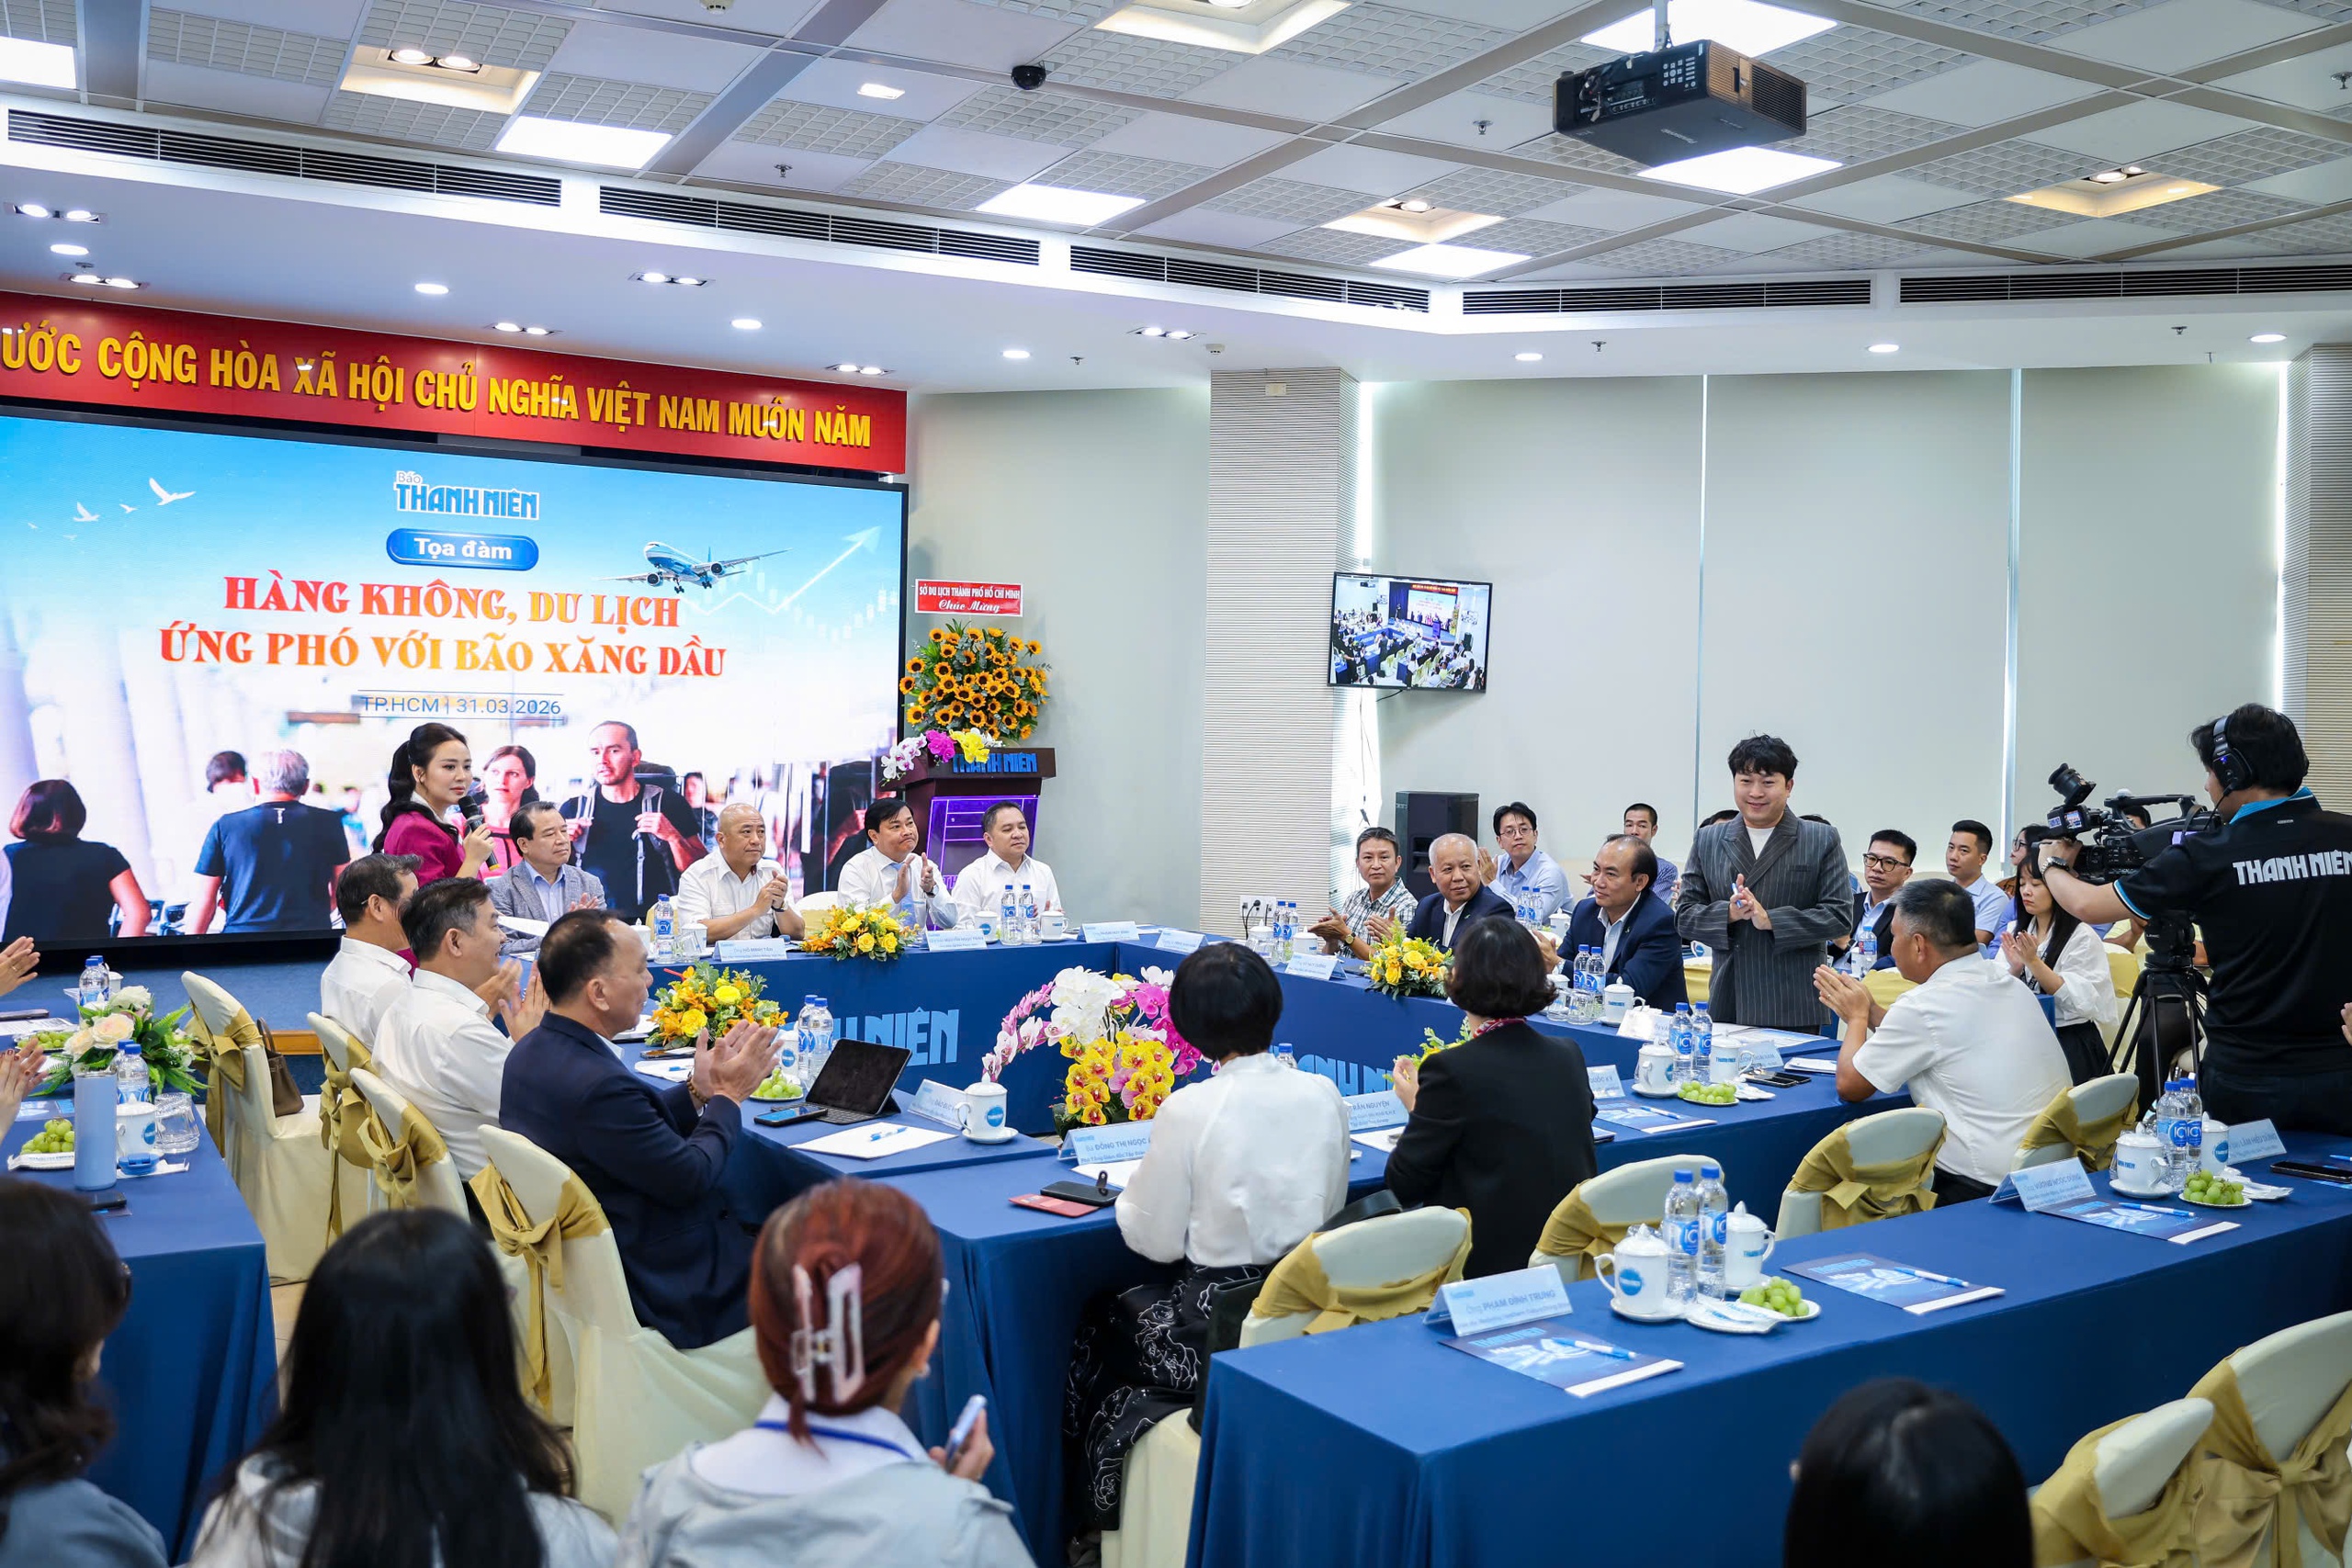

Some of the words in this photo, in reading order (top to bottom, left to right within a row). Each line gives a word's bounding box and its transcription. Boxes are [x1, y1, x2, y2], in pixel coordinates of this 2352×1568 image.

[97, 332, 196, 390] CỘNG
[210, 340, 280, 391] HÒA
[293, 351, 337, 397] XÃ
[349, 355, 404, 411] HỘI
[415, 362, 478, 410] CHỦ
[489, 375, 579, 420] NGHĨA
[587, 380, 650, 433] VIỆT
[659, 395, 719, 434] NAM
[729, 396, 805, 441] MUÔN
[814, 405, 871, 448] NĂM
[395, 483, 480, 514] THANH
[482, 488, 538, 520] NIÊN
[413, 537, 456, 559] Tọa
[461, 539, 513, 559] đàm
[224, 570, 351, 614] HÀNG
[359, 579, 517, 626] KHÔNG,
[528, 591, 583, 624] DU
[592, 593, 681, 634] LỊCH
[939, 599, 966, 610] Chúc
[160, 622, 254, 665] ỨNG
[266, 626, 359, 667] PHÓ
[370, 630, 444, 671] VỚI
[455, 633, 534, 672] BÃO
[544, 637, 648, 676] XĂNG
[659, 634, 727, 677] DẦU
[360, 696, 439, 712] TP.HCM
[457, 698, 561, 715] 31.03.2026
[1003, 752, 1038, 773] NIÊN
[2233, 854, 2309, 886] THANH
[1702, 1038, 1712, 1048] IC
[1685, 1228, 1698, 1244] IC
